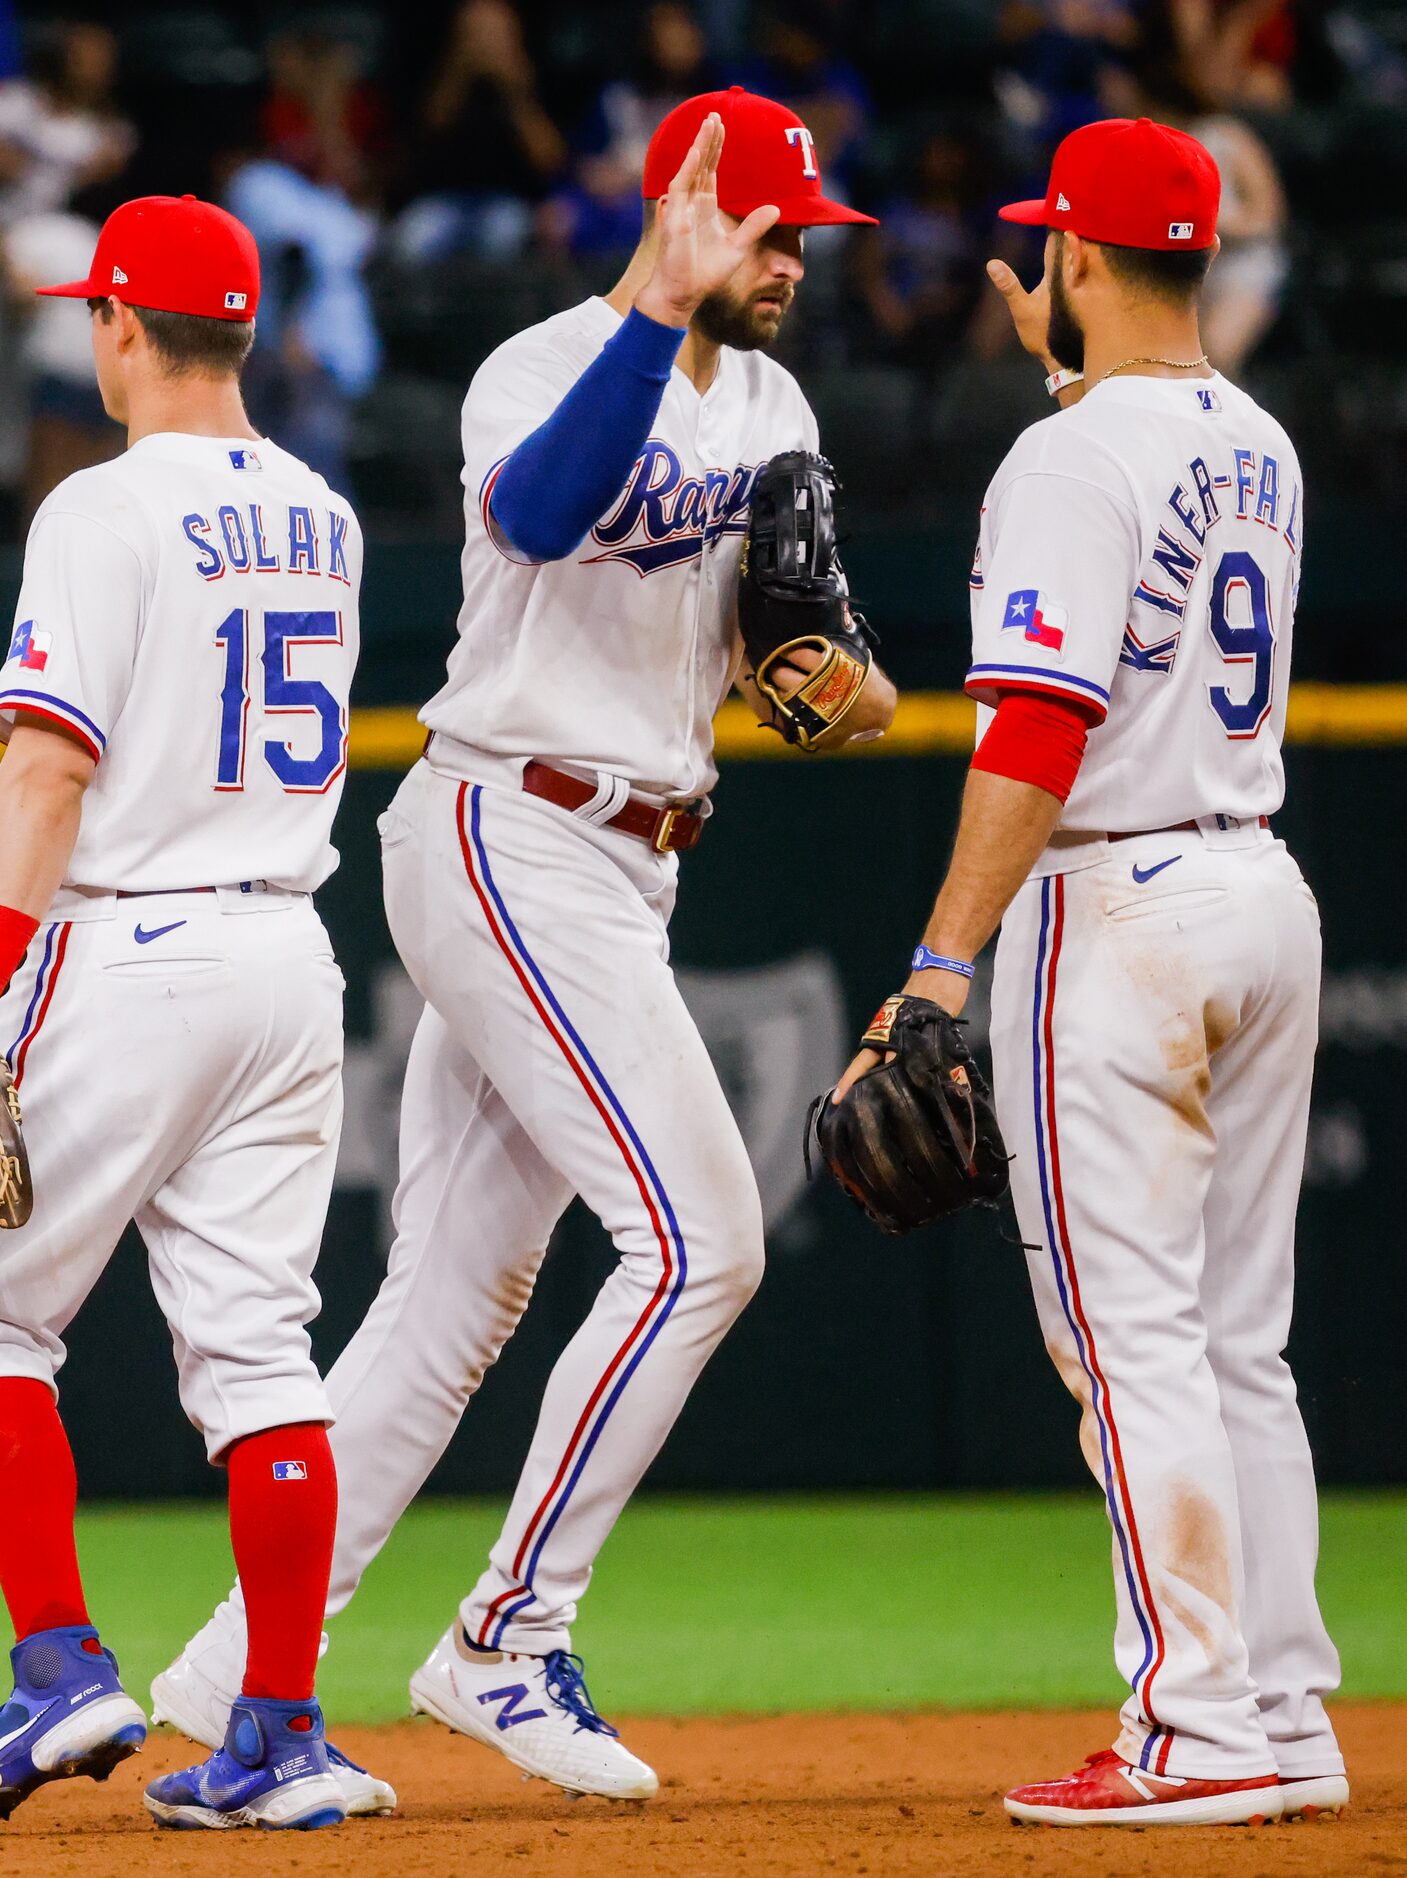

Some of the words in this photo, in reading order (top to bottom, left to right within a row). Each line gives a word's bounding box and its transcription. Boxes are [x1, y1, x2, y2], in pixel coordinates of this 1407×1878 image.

[784, 127, 817, 180] T
[181, 502, 352, 587] SOLAK
[212, 606, 349, 795] 15
[1206, 550, 1276, 740] 9
